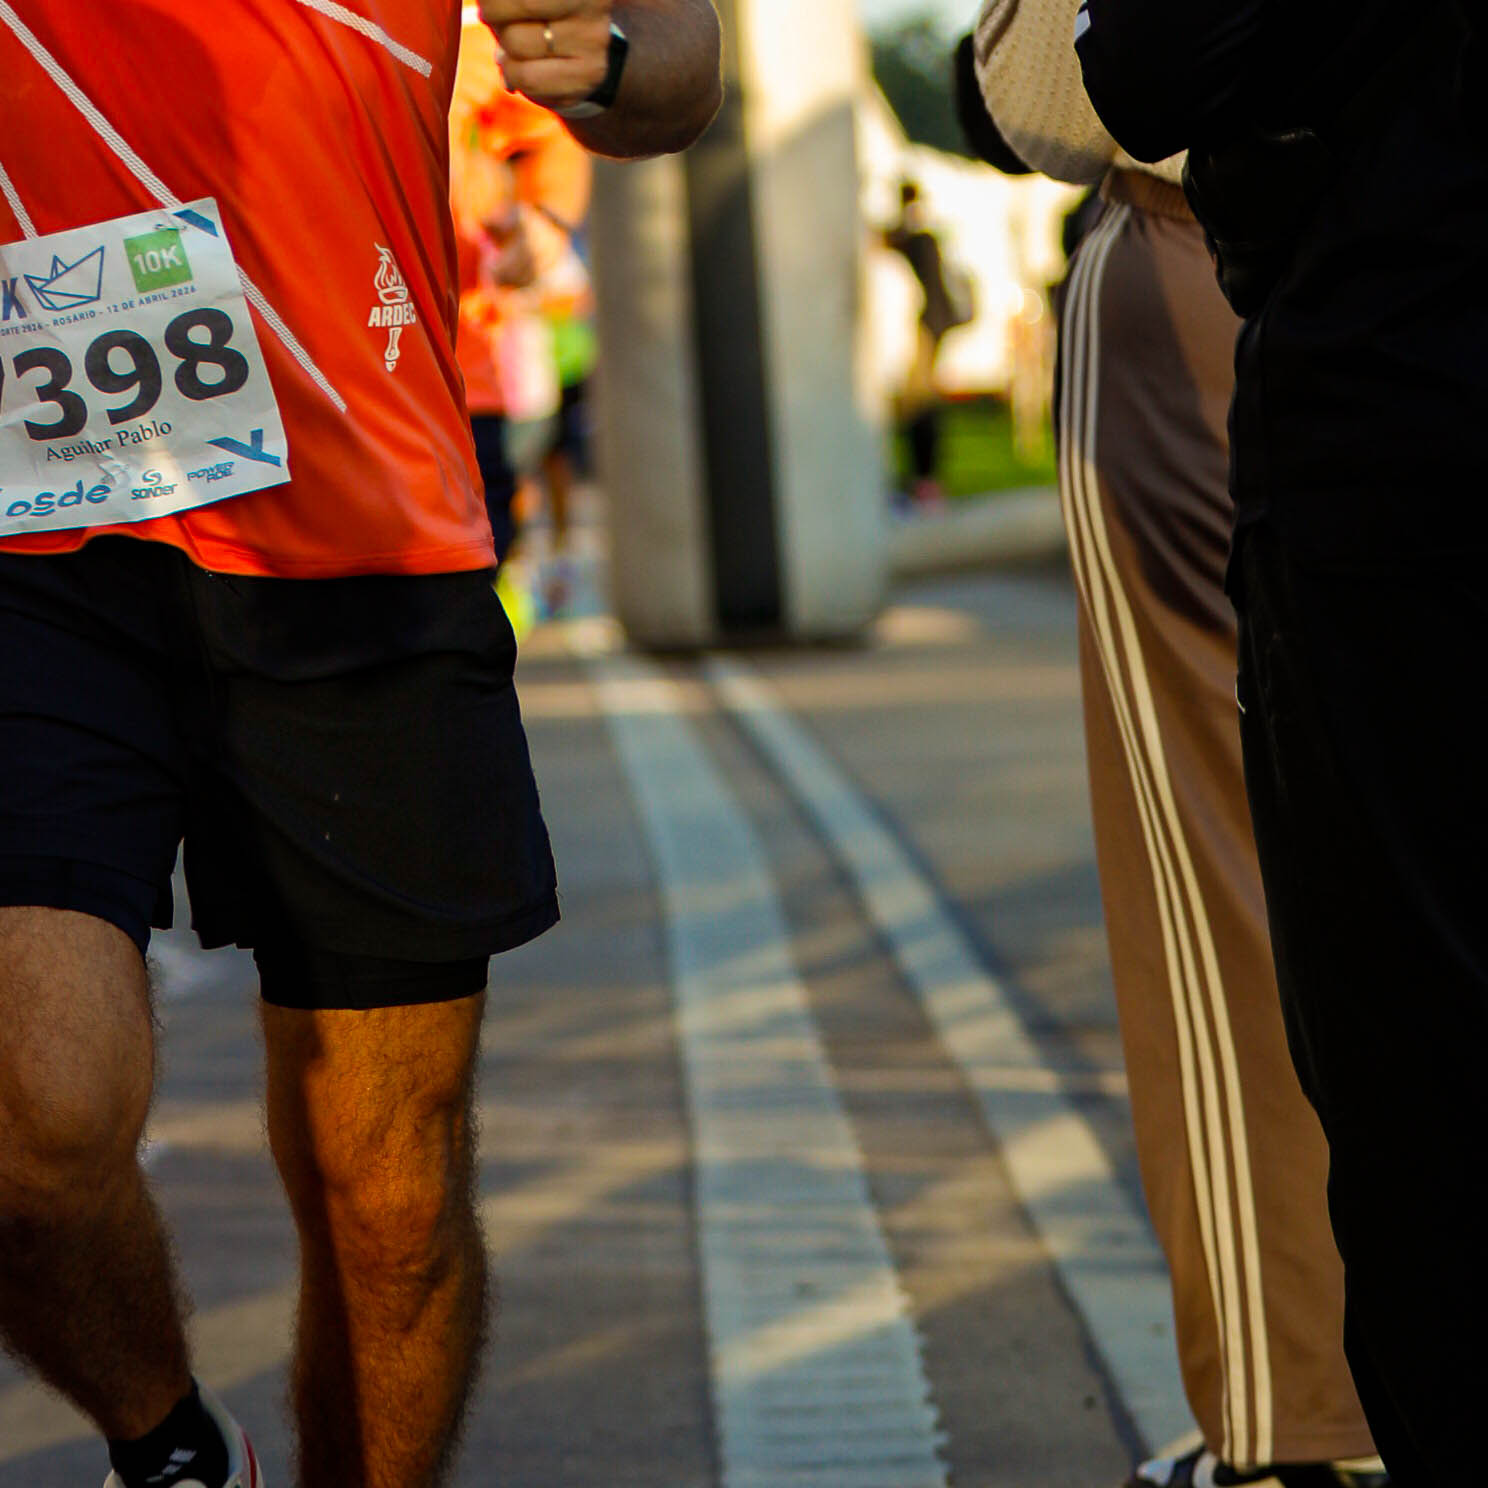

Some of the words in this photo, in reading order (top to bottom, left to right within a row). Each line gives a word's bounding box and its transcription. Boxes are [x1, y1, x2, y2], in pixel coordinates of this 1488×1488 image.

[133, 245, 182, 276] 10K
[52, 310, 96, 328] ROSARIO
[107, 304, 120, 314] 12
[121, 299, 136, 310] DE
[138, 292, 168, 307] ABRIL
[171, 285, 197, 299] 2026
[47, 438, 112, 462] Aguilar
[115, 420, 172, 448] Pablo
[5, 479, 112, 517] osde
